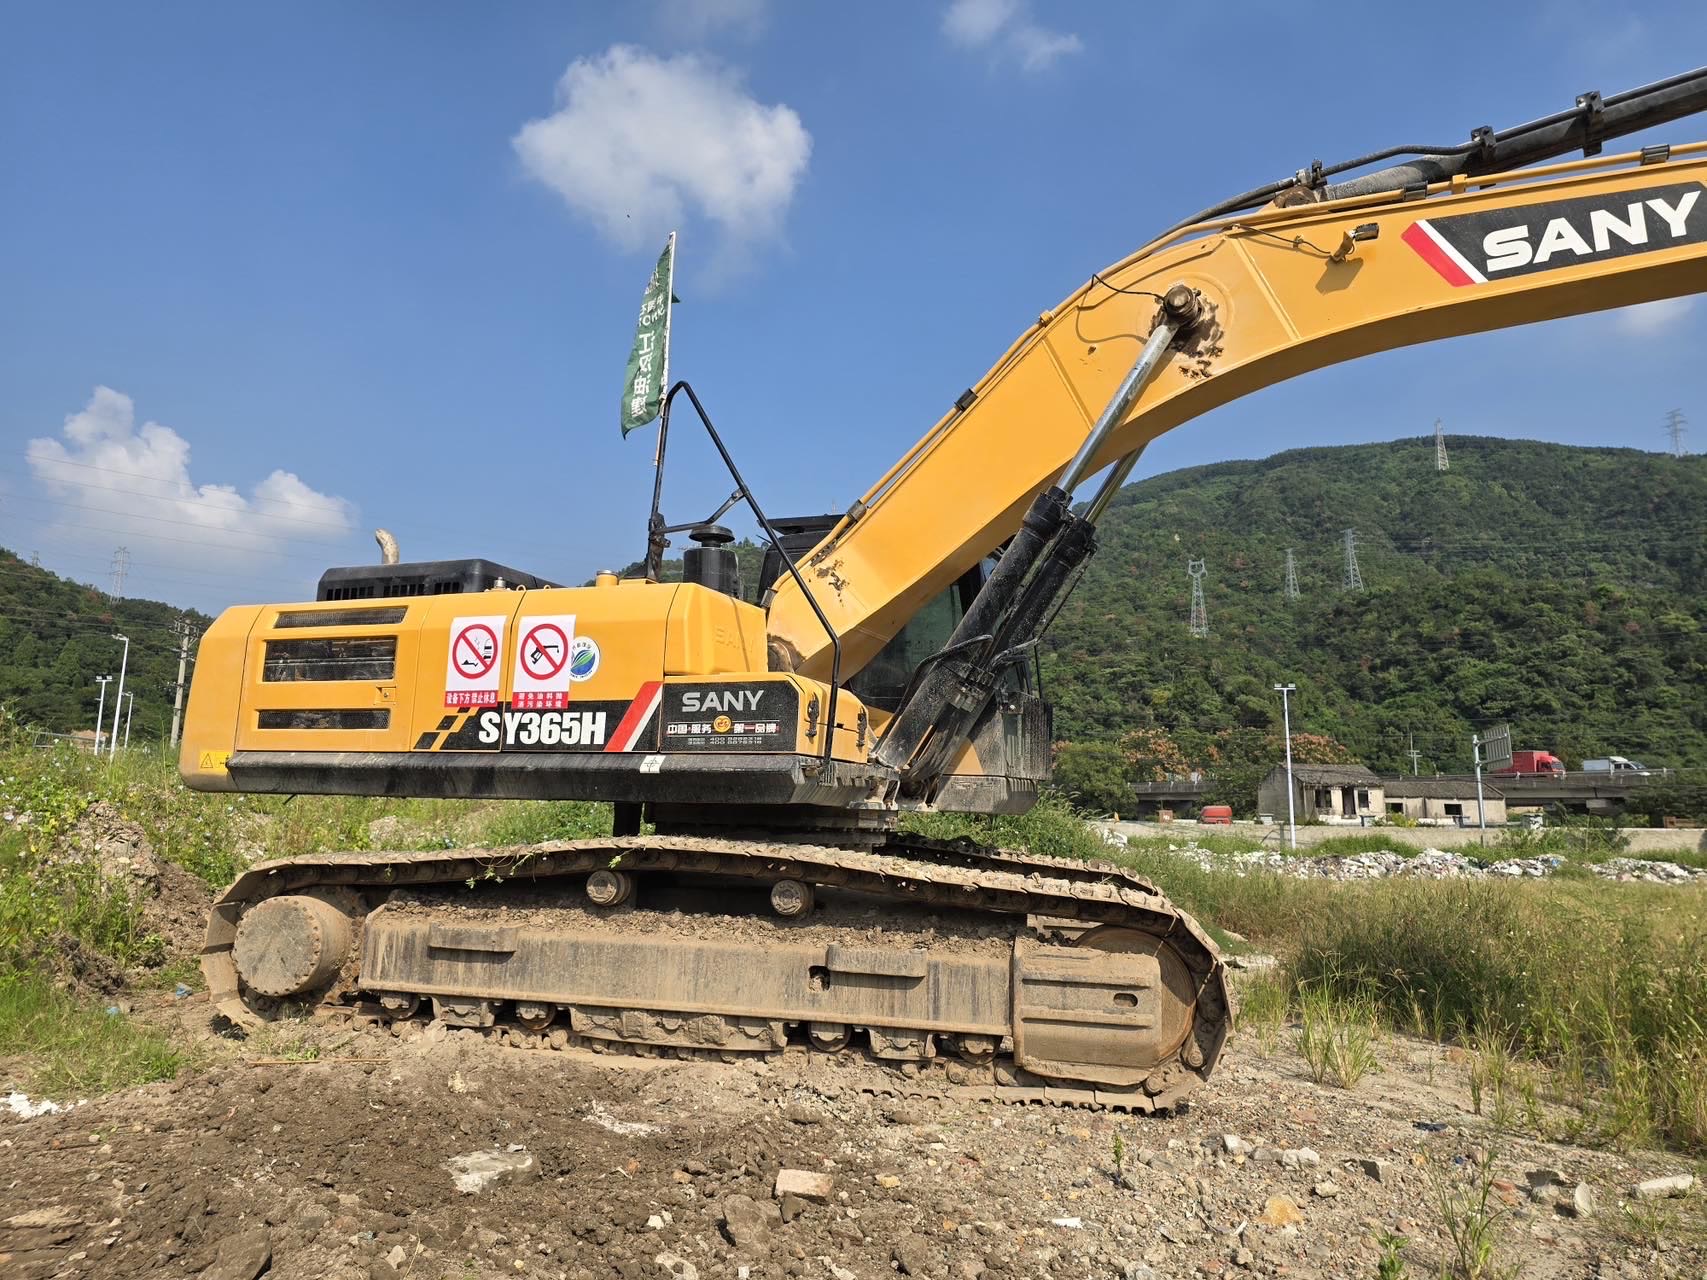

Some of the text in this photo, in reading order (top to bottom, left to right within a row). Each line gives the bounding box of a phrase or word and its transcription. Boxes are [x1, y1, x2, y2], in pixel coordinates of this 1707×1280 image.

[1483, 190, 1701, 272] SANY
[682, 690, 764, 712] SANY
[478, 711, 607, 745] SY365H
